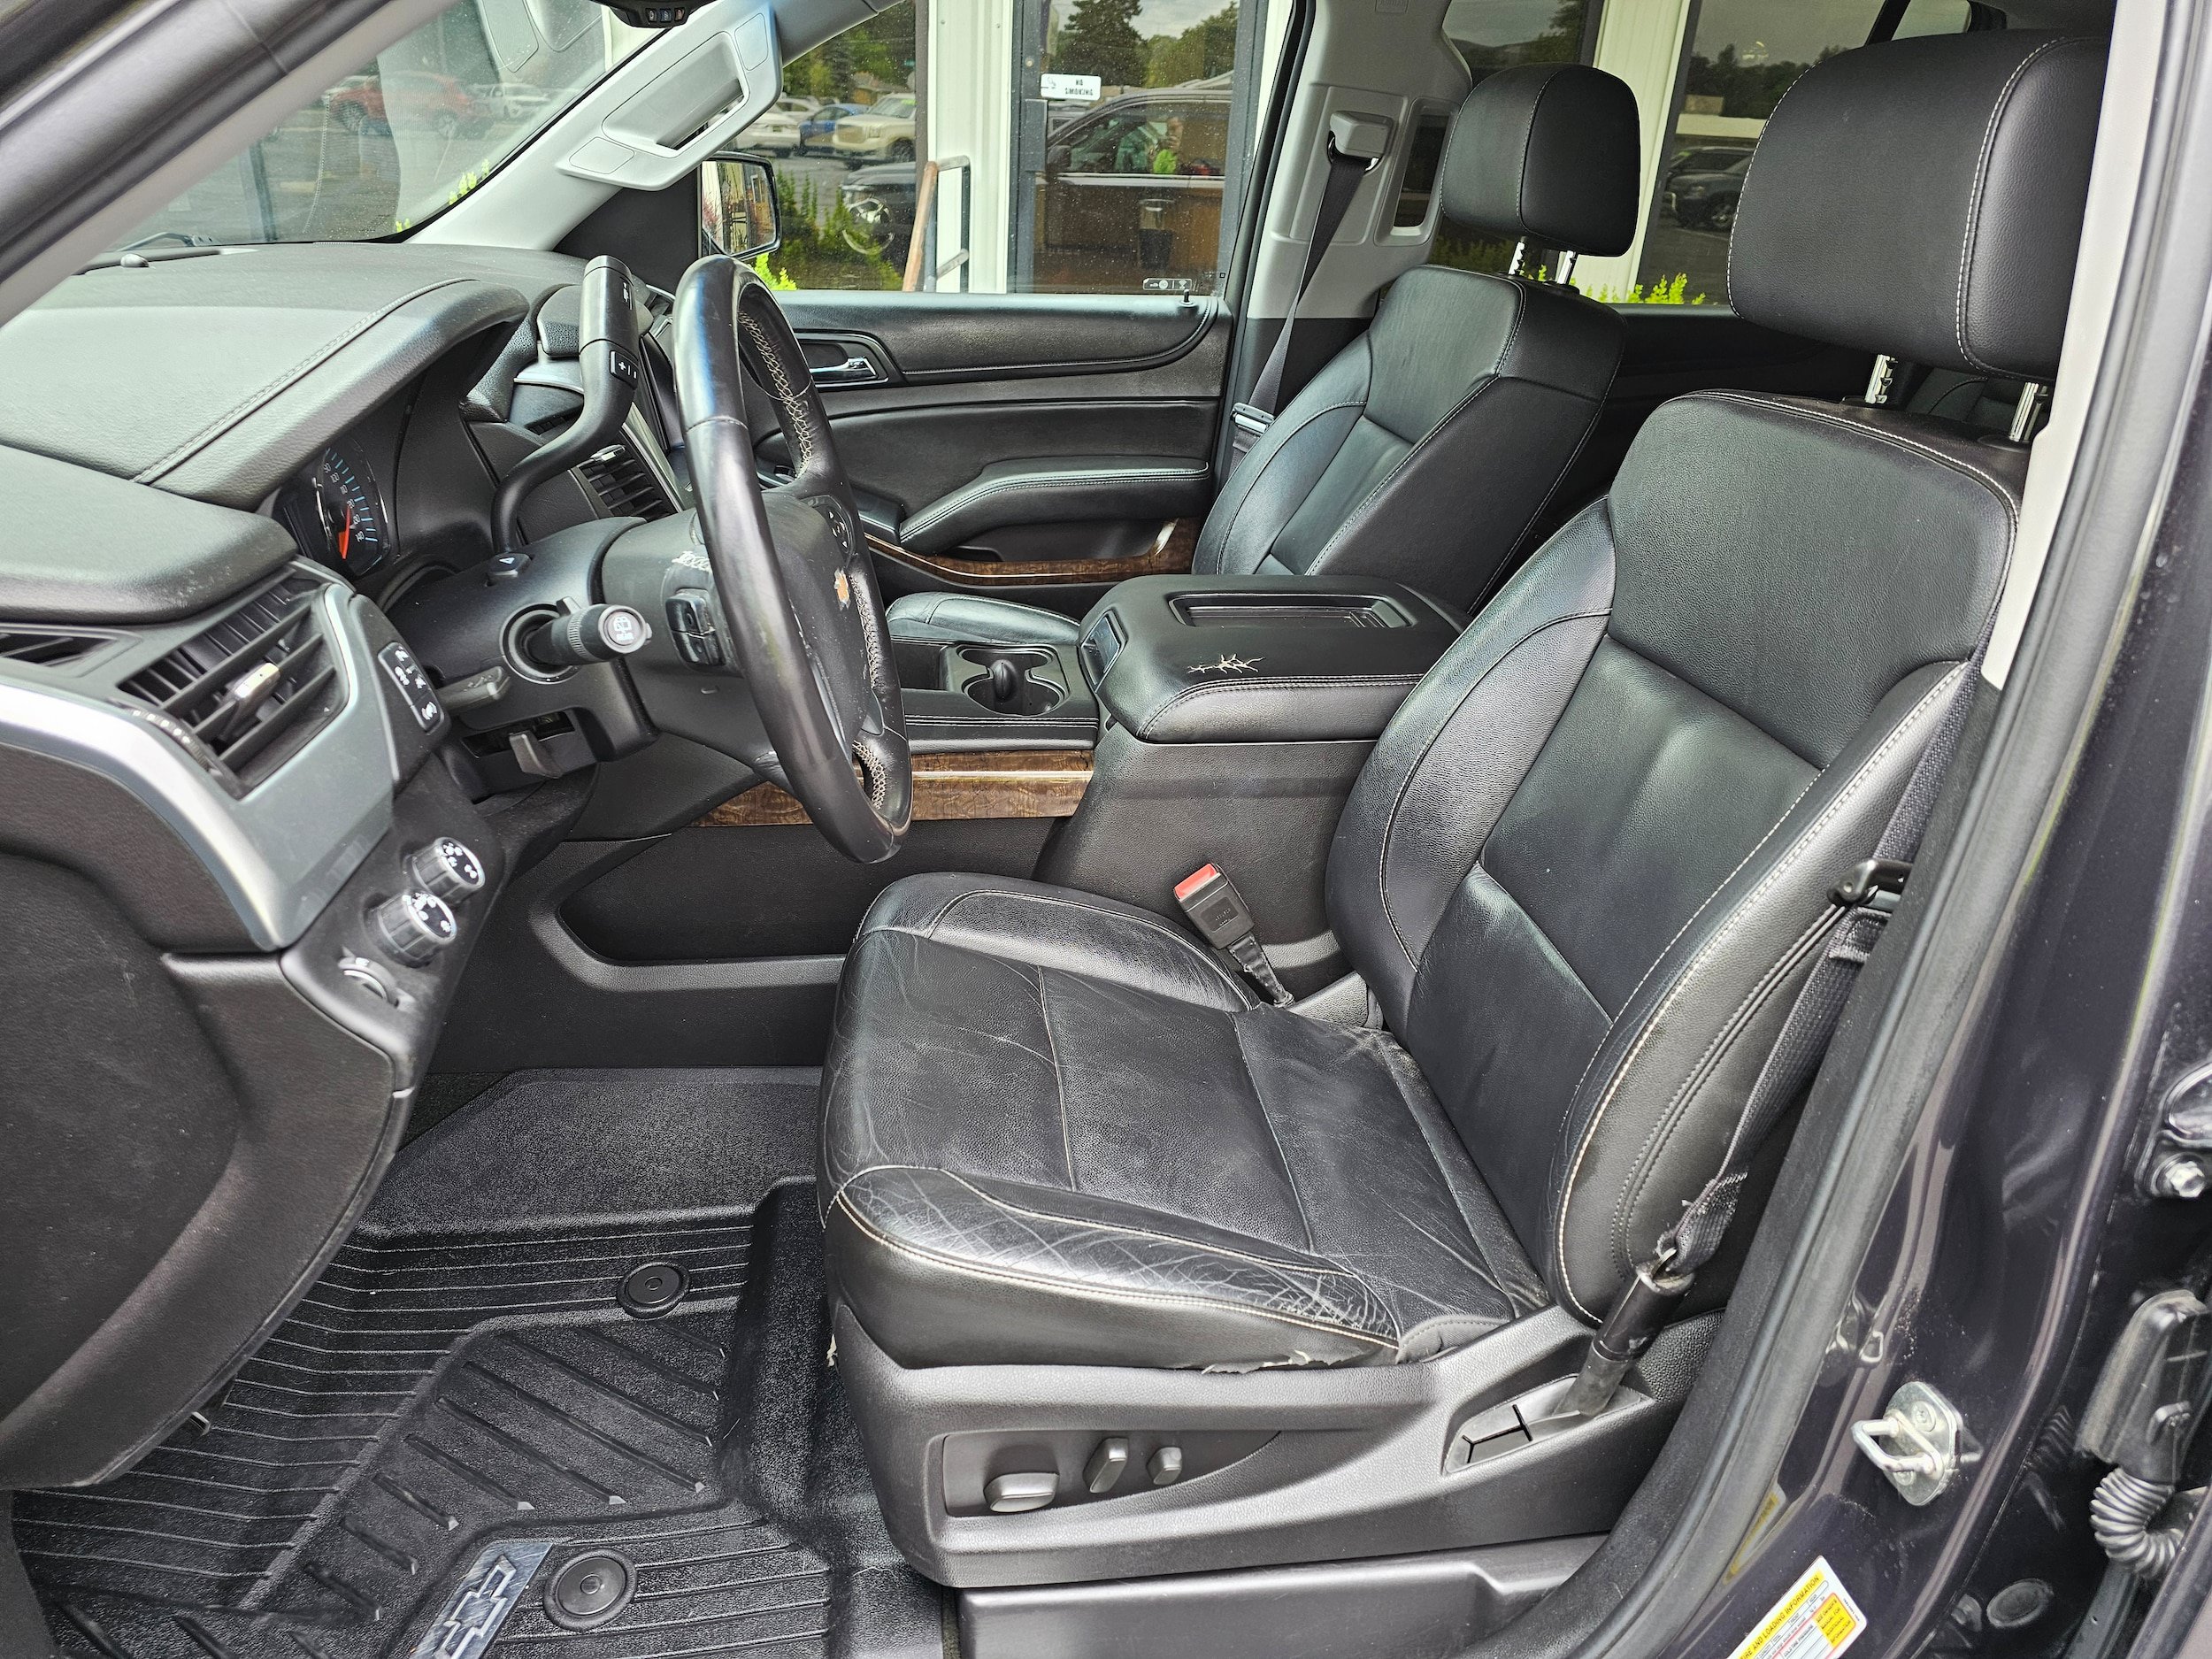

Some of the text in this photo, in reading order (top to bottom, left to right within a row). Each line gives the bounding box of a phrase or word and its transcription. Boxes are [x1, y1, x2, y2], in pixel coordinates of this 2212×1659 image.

[1064, 87, 1094, 96] SMOKING
[1751, 1634, 1763, 1650] AND
[1762, 1611, 1786, 1639] LOADING
[1783, 1574, 1819, 1614] INFORMATION
